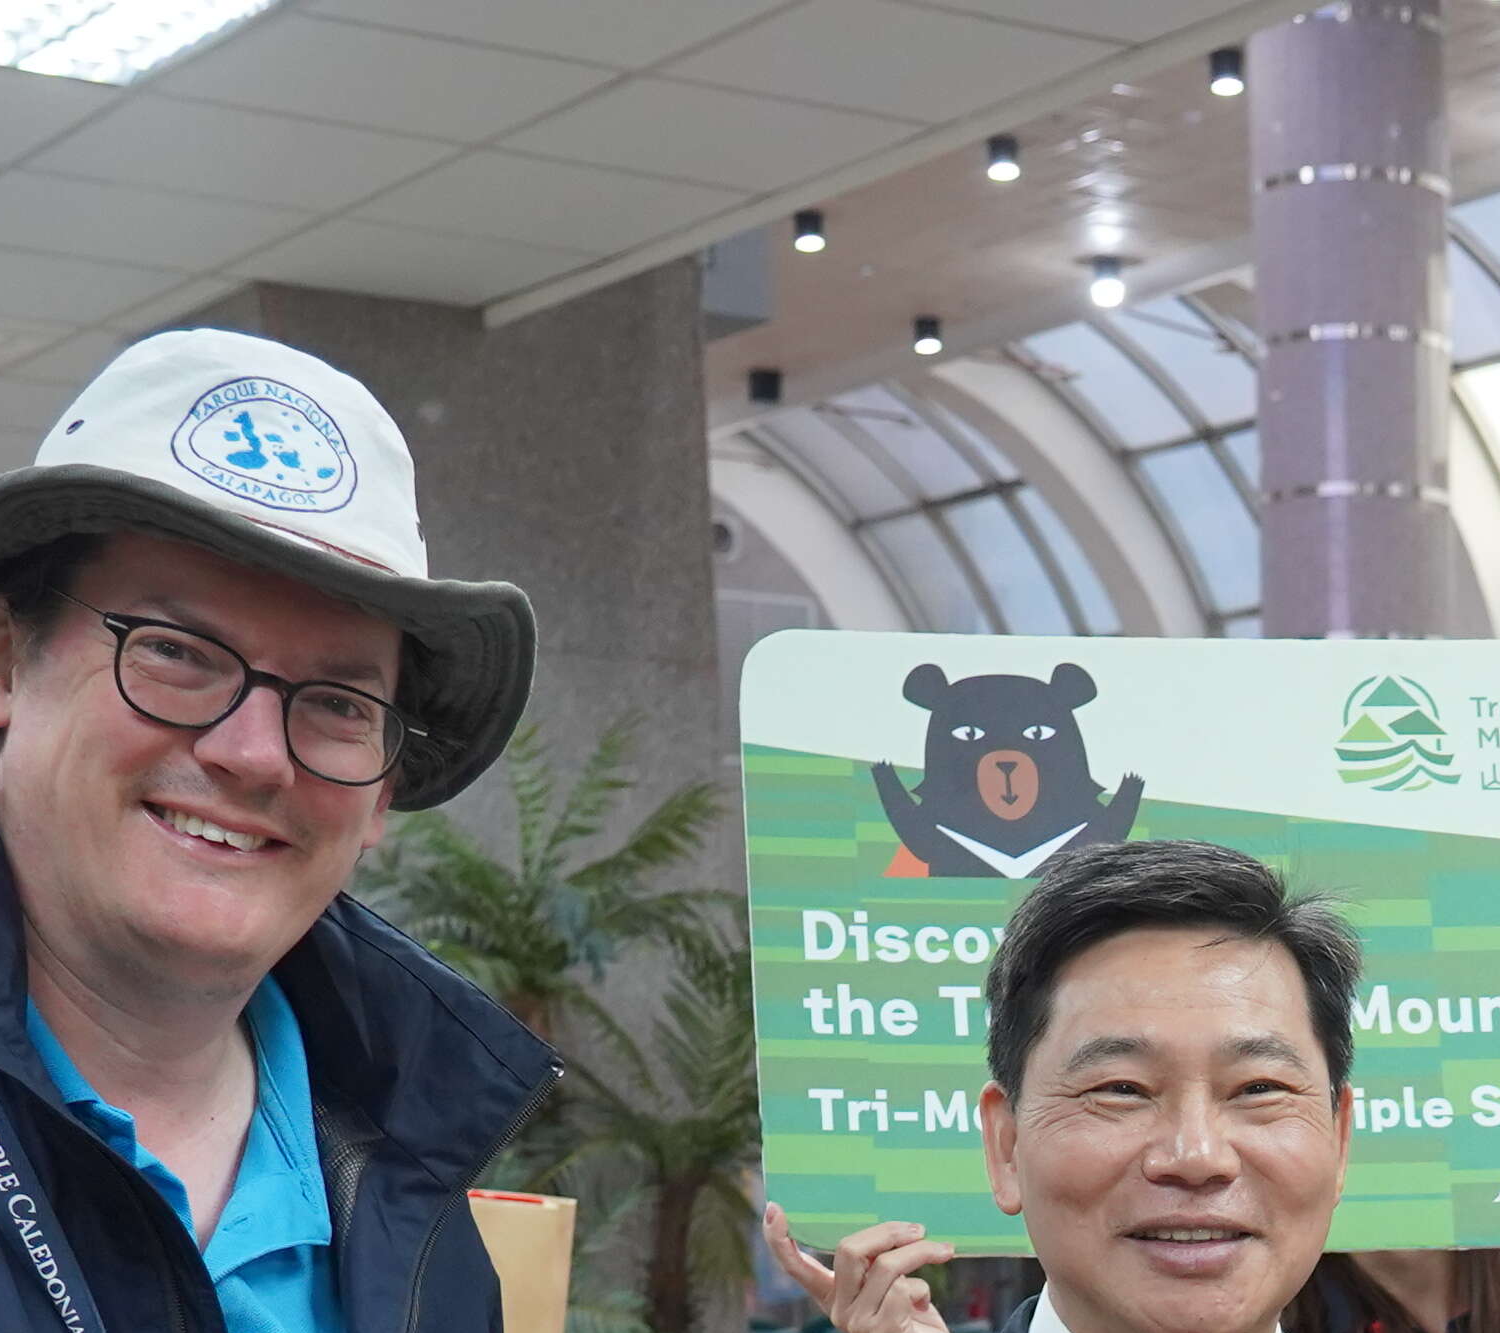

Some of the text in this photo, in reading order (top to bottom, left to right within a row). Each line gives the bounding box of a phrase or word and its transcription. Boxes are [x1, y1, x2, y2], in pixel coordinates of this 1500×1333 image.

[190, 381, 348, 456] PARQUE NACIONAL
[201, 465, 317, 506] GALAPAGOS
[803, 983, 919, 1037] the
[938, 985, 992, 1037] T
[807, 1088, 983, 1133] Tri-M
[1353, 1086, 1454, 1133] iple
